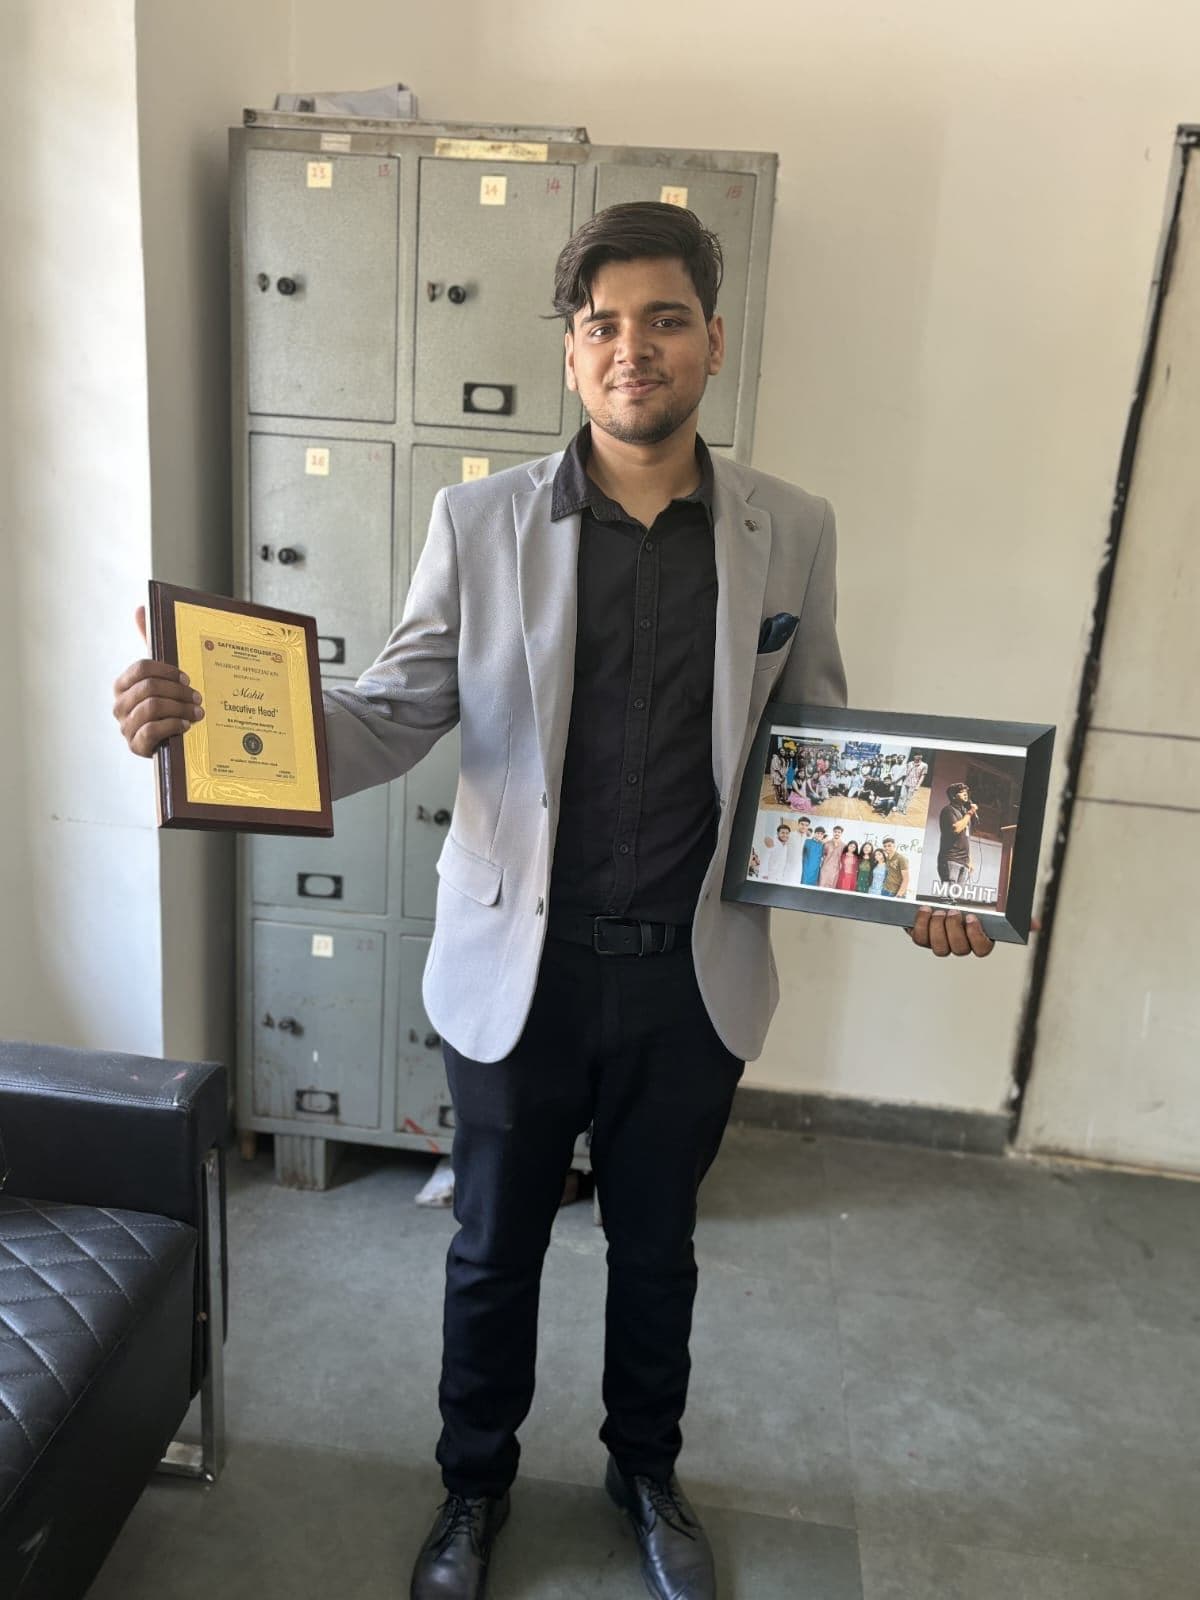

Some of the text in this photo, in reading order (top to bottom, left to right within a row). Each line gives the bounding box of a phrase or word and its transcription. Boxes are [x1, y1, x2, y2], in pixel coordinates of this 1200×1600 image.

[484, 183, 498, 196] 14
[546, 177, 560, 194] 14
[232, 687, 264, 700] Mohit
[932, 880, 996, 904] MOHIT
